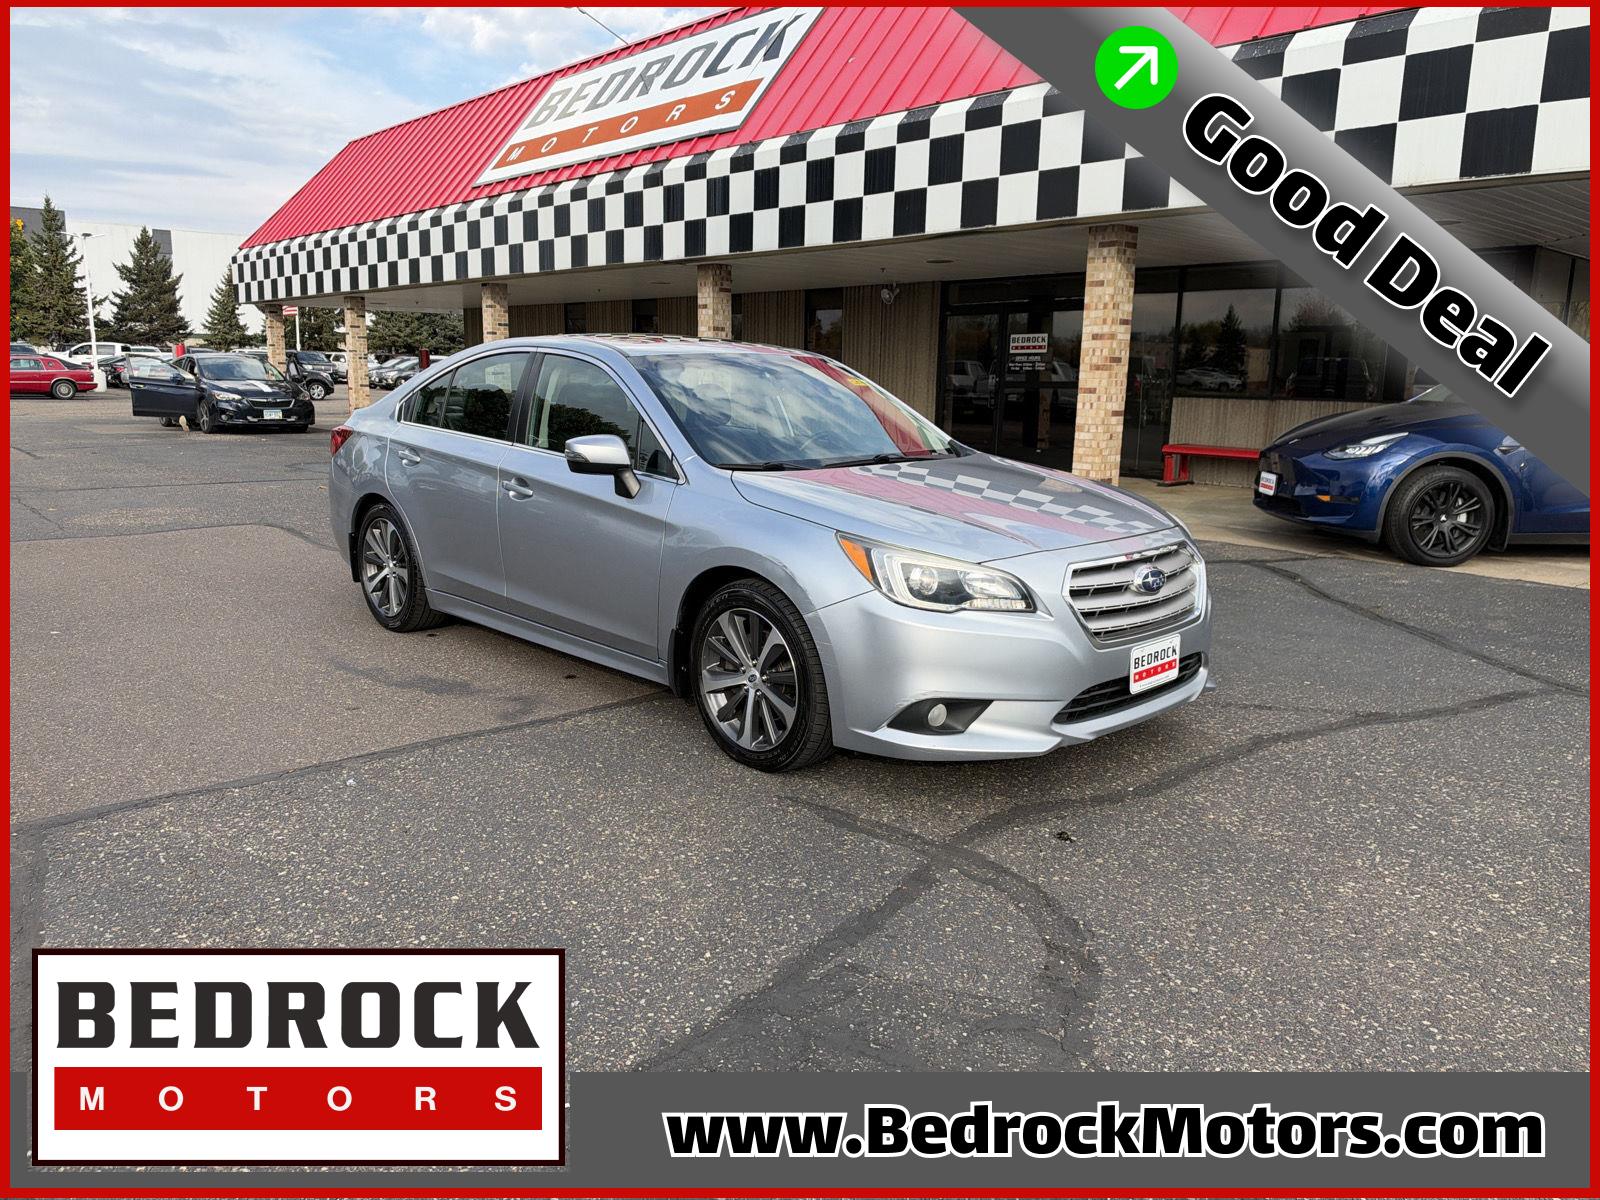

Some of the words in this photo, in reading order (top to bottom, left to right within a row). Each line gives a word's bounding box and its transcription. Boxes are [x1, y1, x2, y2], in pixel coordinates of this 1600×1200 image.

[523, 12, 807, 130] BEDROCK
[507, 90, 736, 162] MOTORS
[1011, 336, 1046, 344] BEDROCK
[1134, 645, 1177, 669] BEDROCK
